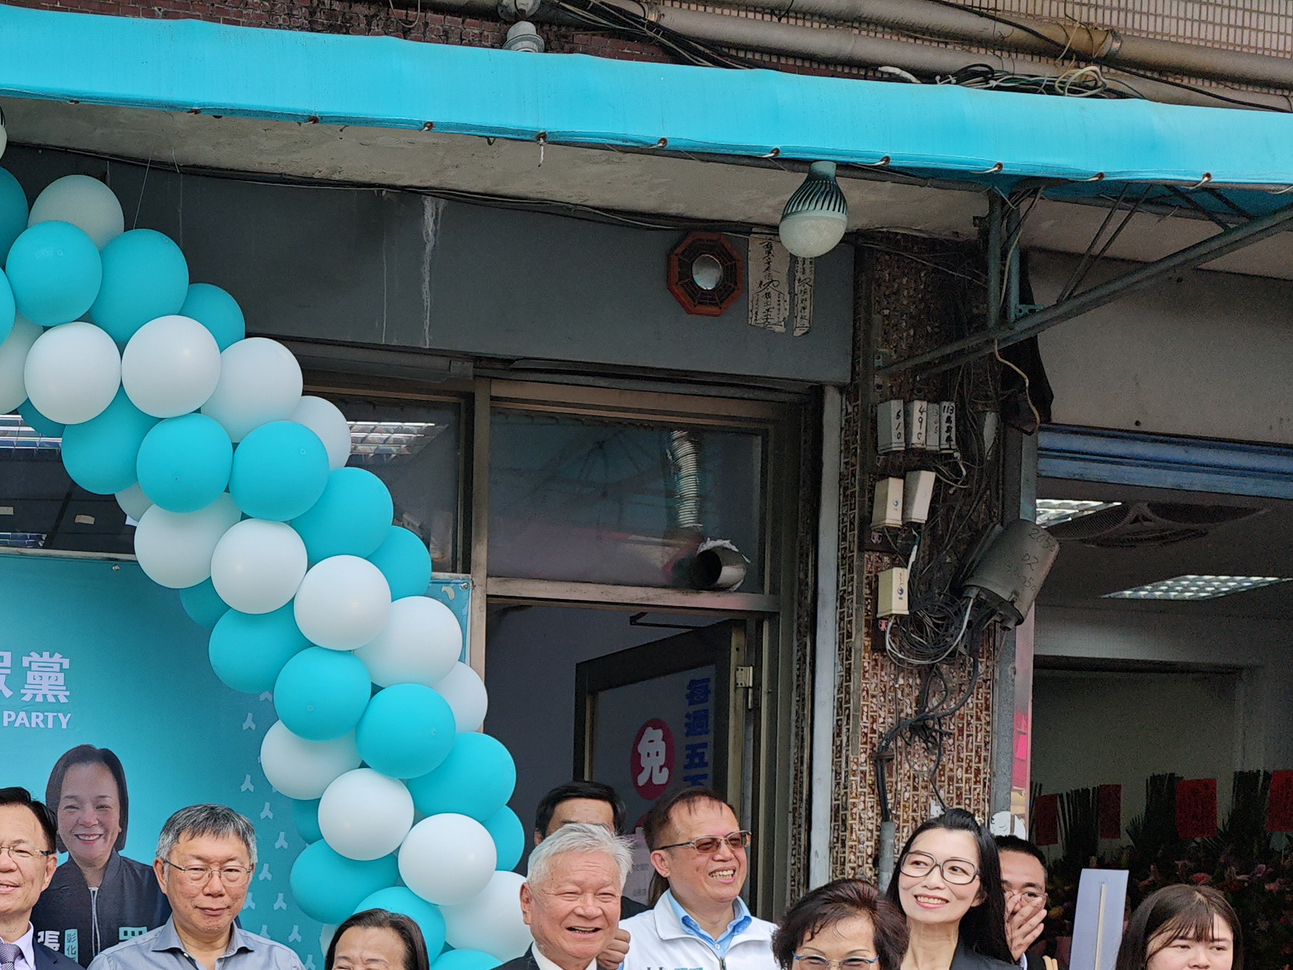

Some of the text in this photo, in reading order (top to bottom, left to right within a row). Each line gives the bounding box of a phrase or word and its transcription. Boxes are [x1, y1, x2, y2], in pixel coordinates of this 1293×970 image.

[2, 710, 71, 729] PARTY
[637, 726, 670, 787] 免
[66, 932, 77, 957] 彰化
